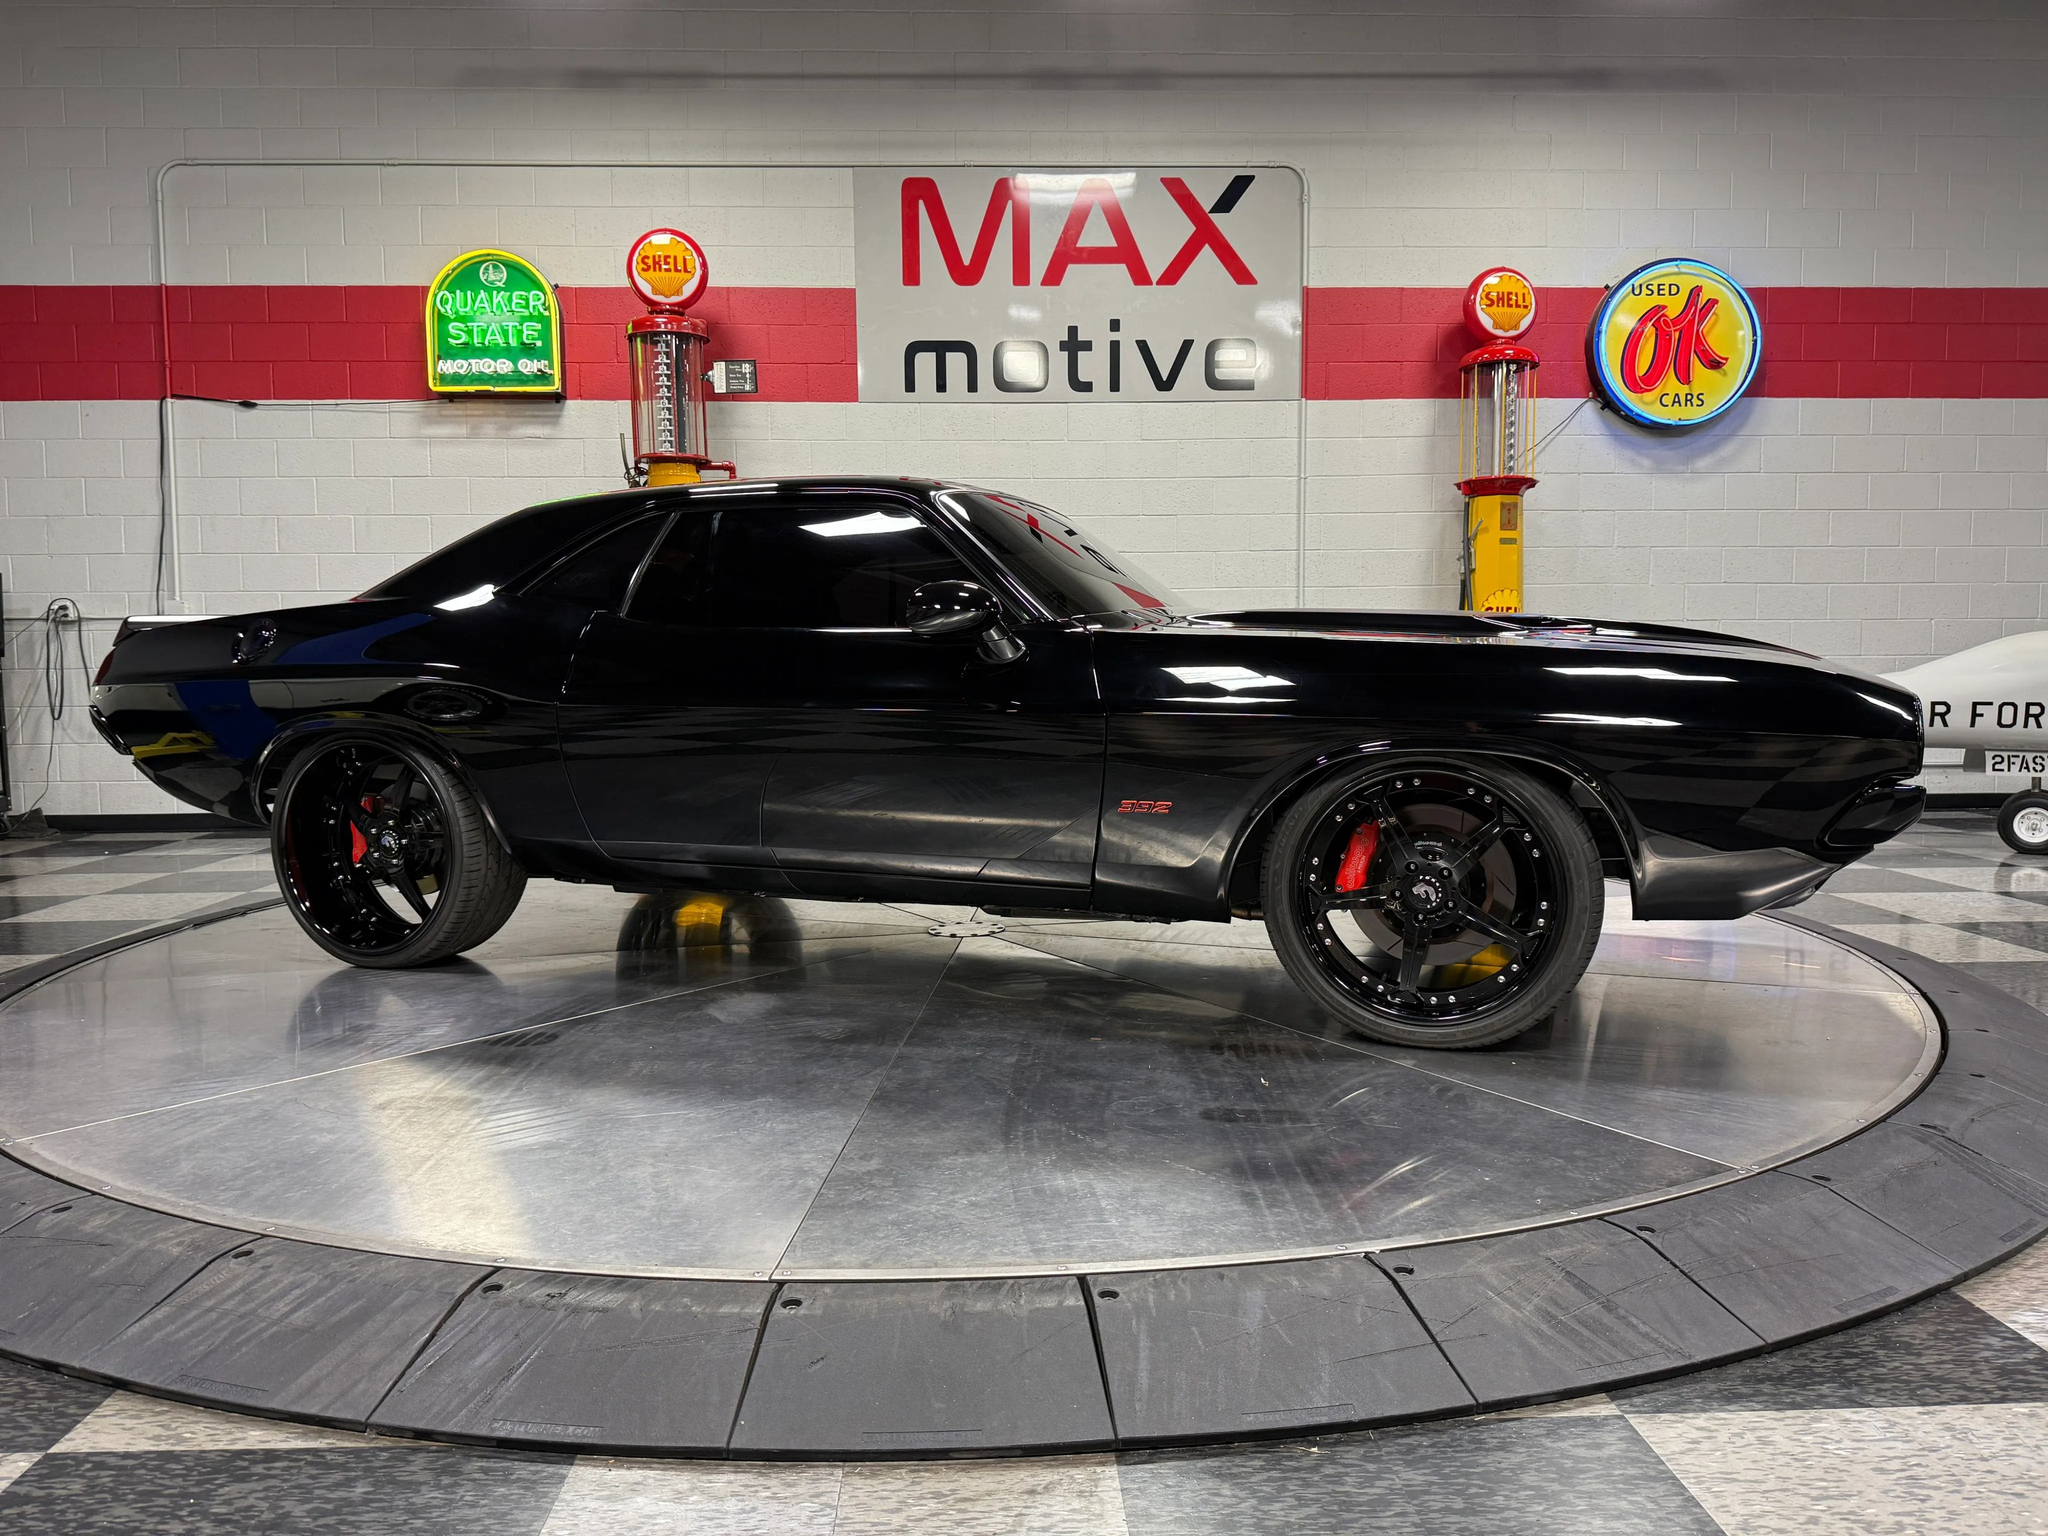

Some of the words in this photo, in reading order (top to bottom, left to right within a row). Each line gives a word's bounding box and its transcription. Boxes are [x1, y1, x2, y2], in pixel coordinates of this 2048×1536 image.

[901, 175, 1258, 286] MAX
[640, 254, 692, 274] SHELL
[1484, 290, 1530, 310] SHELL
[1632, 283, 1681, 297] USED
[436, 290, 549, 319] QUAKER
[447, 322, 542, 346] STATE
[1620, 285, 1729, 395] OK
[437, 358, 515, 375] MOTOR
[517, 358, 554, 375] OIL
[904, 318, 1257, 393] motive
[1659, 392, 1705, 408] CARS
[1117, 800, 1173, 814] 392
[1345, 836, 1370, 889] wilwood
